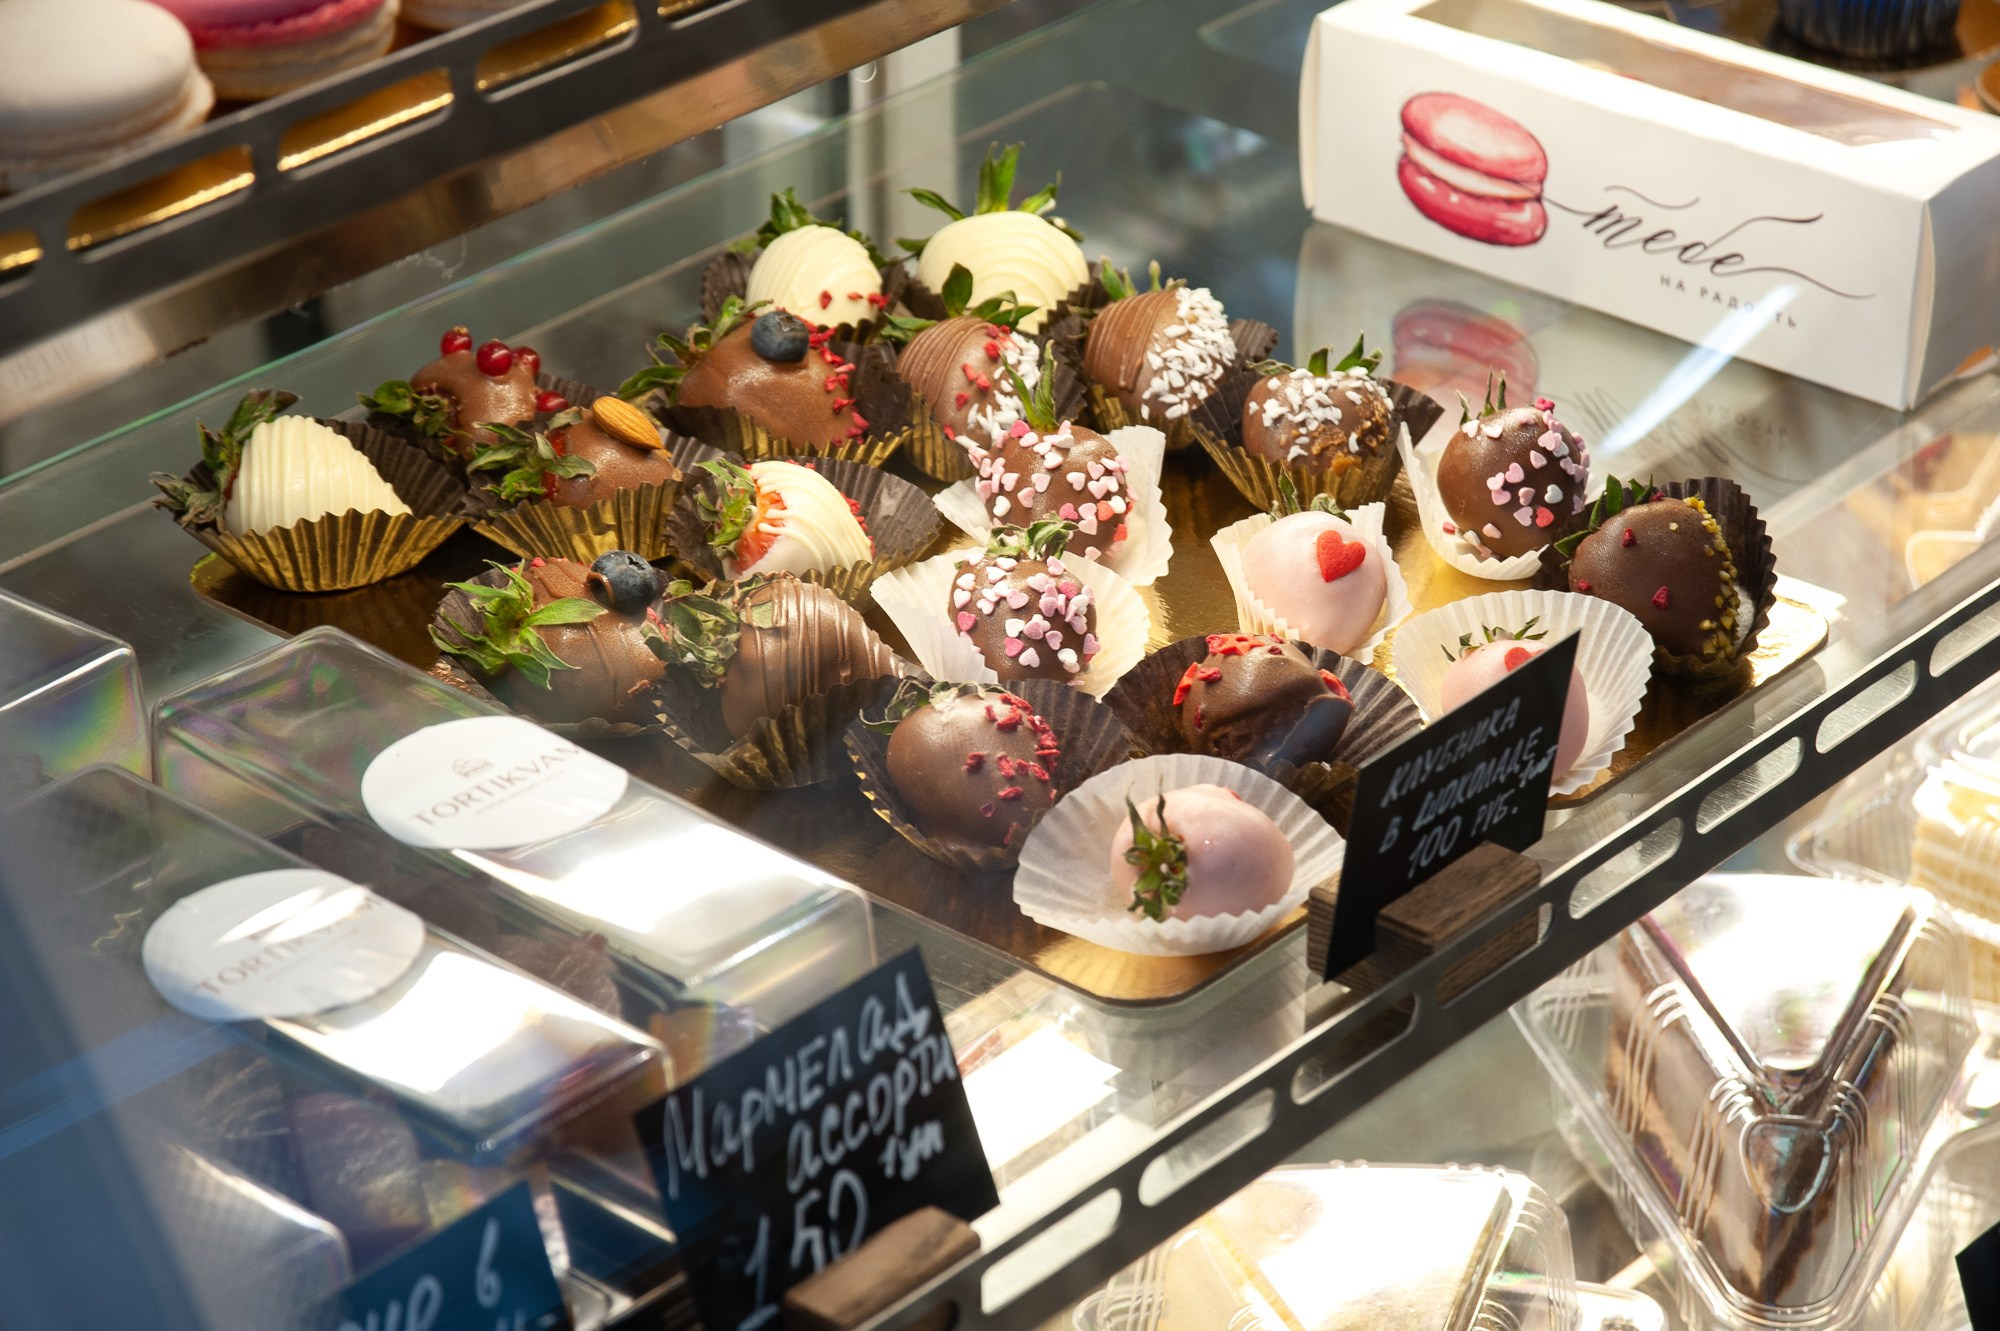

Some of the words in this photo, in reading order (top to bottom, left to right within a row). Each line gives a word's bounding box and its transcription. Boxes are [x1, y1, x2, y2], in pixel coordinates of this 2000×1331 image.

[1659, 274, 1686, 293] НА
[1700, 285, 1798, 329] РАДОТЬ
[1380, 697, 1521, 808] КЛУБНИКА
[1411, 726, 1543, 832] ШОКОЛАДЕ
[1407, 815, 1462, 879] 100
[1470, 788, 1519, 837] РУБ.
[737, 1169, 868, 1331] 150
